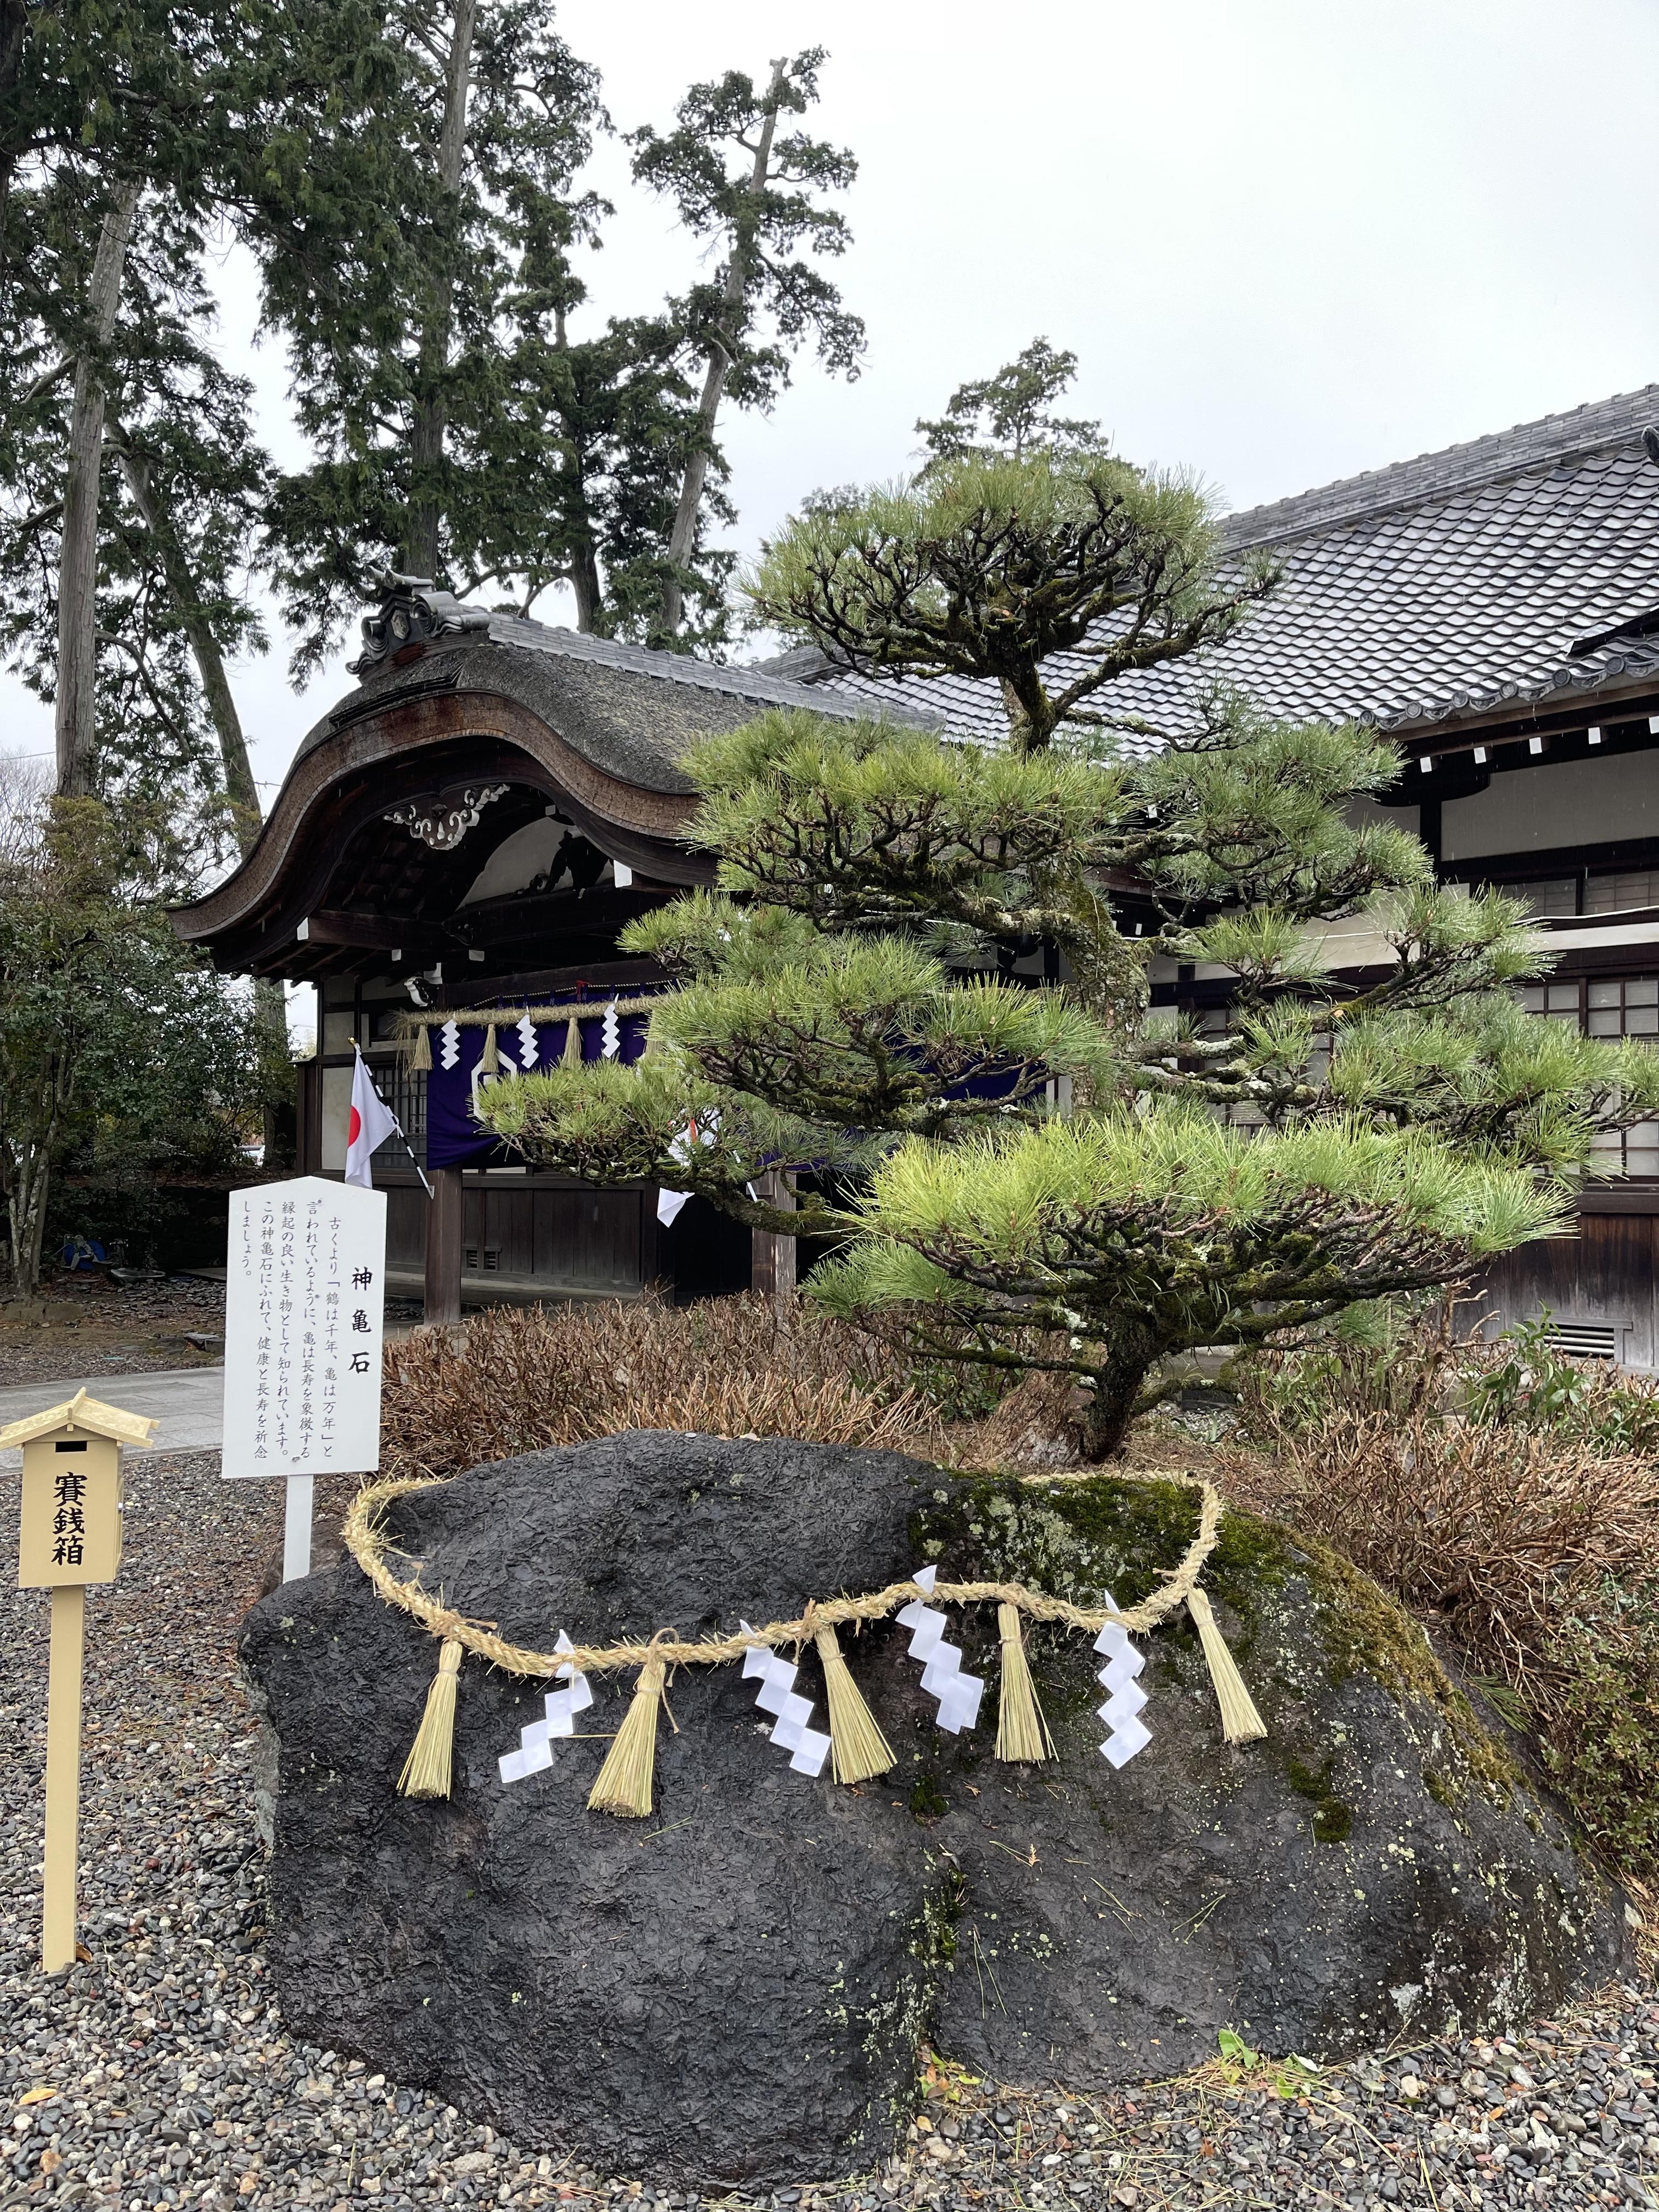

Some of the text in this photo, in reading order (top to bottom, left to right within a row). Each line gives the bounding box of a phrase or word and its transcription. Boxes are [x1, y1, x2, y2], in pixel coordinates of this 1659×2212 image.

[242, 1200, 252, 1276] しましょう。
[254, 1201, 274, 1459] この神亀石にふれて、健康と長寿を祈念
[275, 1201, 295, 1455] 縁起の良い生き物として知られています。
[348, 1267, 373, 1374] 神亀石
[51, 1471, 88, 1566] 賽銭箱
